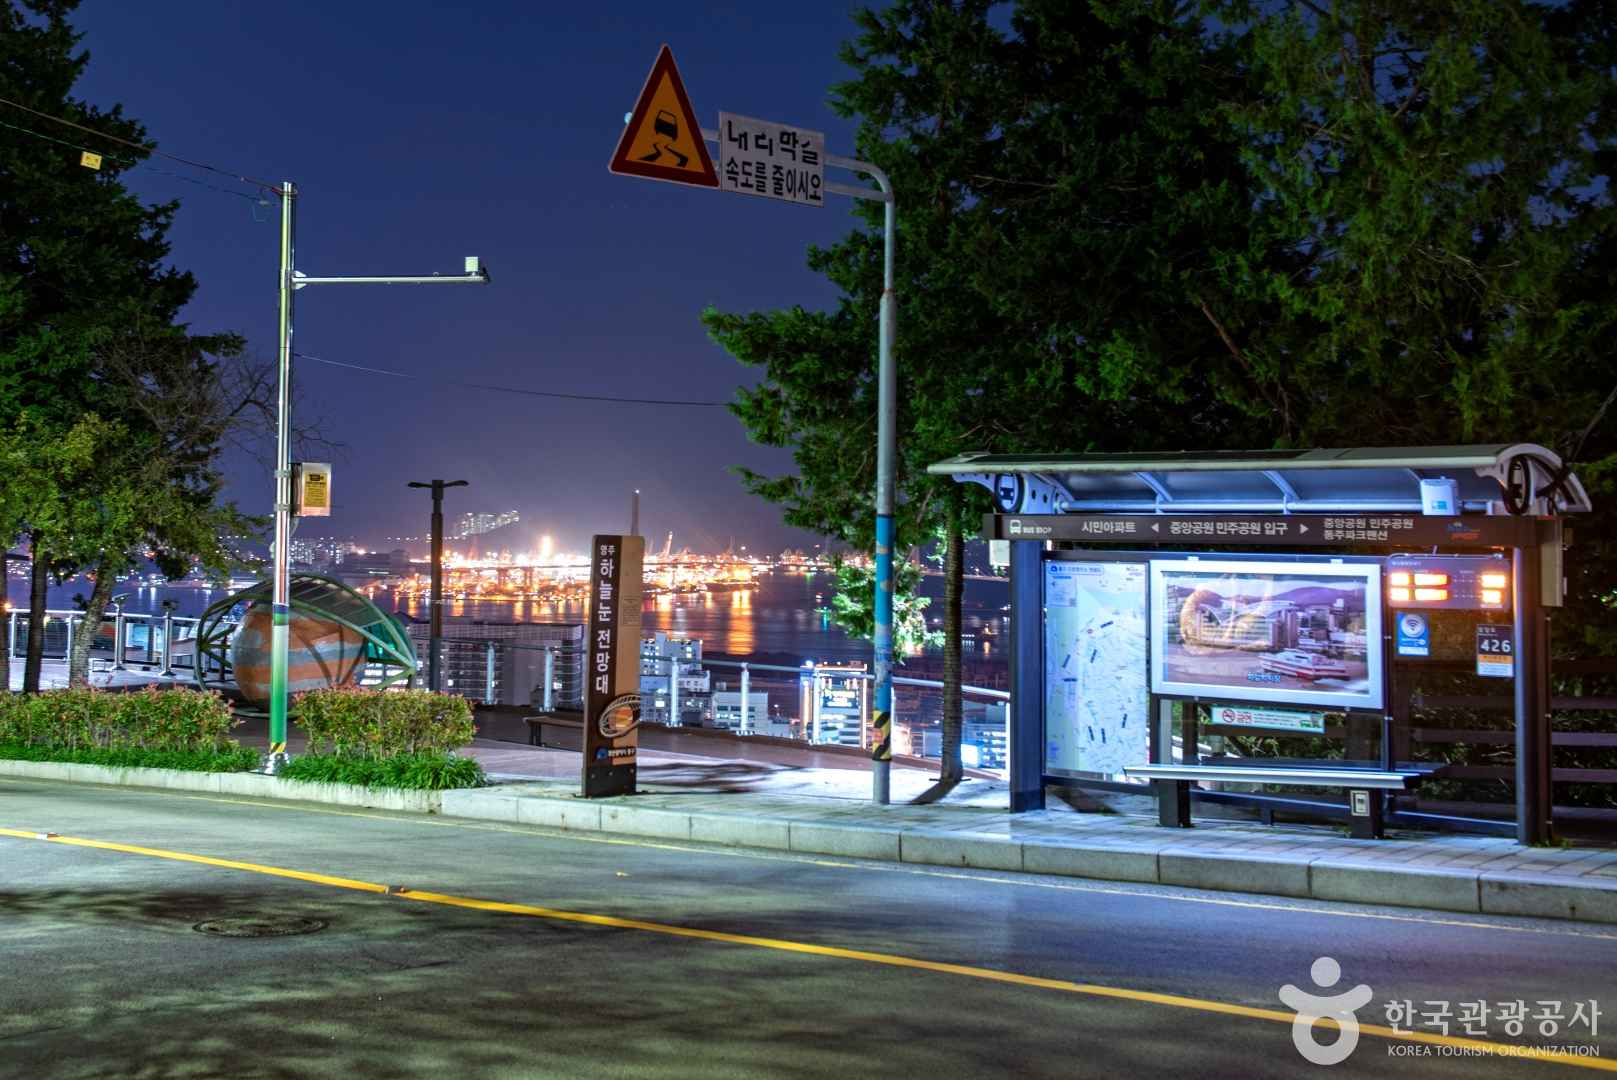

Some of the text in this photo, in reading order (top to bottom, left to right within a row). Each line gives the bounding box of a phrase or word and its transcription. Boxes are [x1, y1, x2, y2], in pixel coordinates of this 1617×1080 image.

[726, 156, 822, 201] 속도를 줄이시오
[1081, 521, 1137, 534] 시민아파트
[1169, 521, 1288, 535] 중앙공원 민주공원 입구
[1324, 518, 1413, 530] 중앙공원 민주공원
[595, 558, 614, 695] 하늘눈 전망대
[1480, 639, 1511, 653] 426
